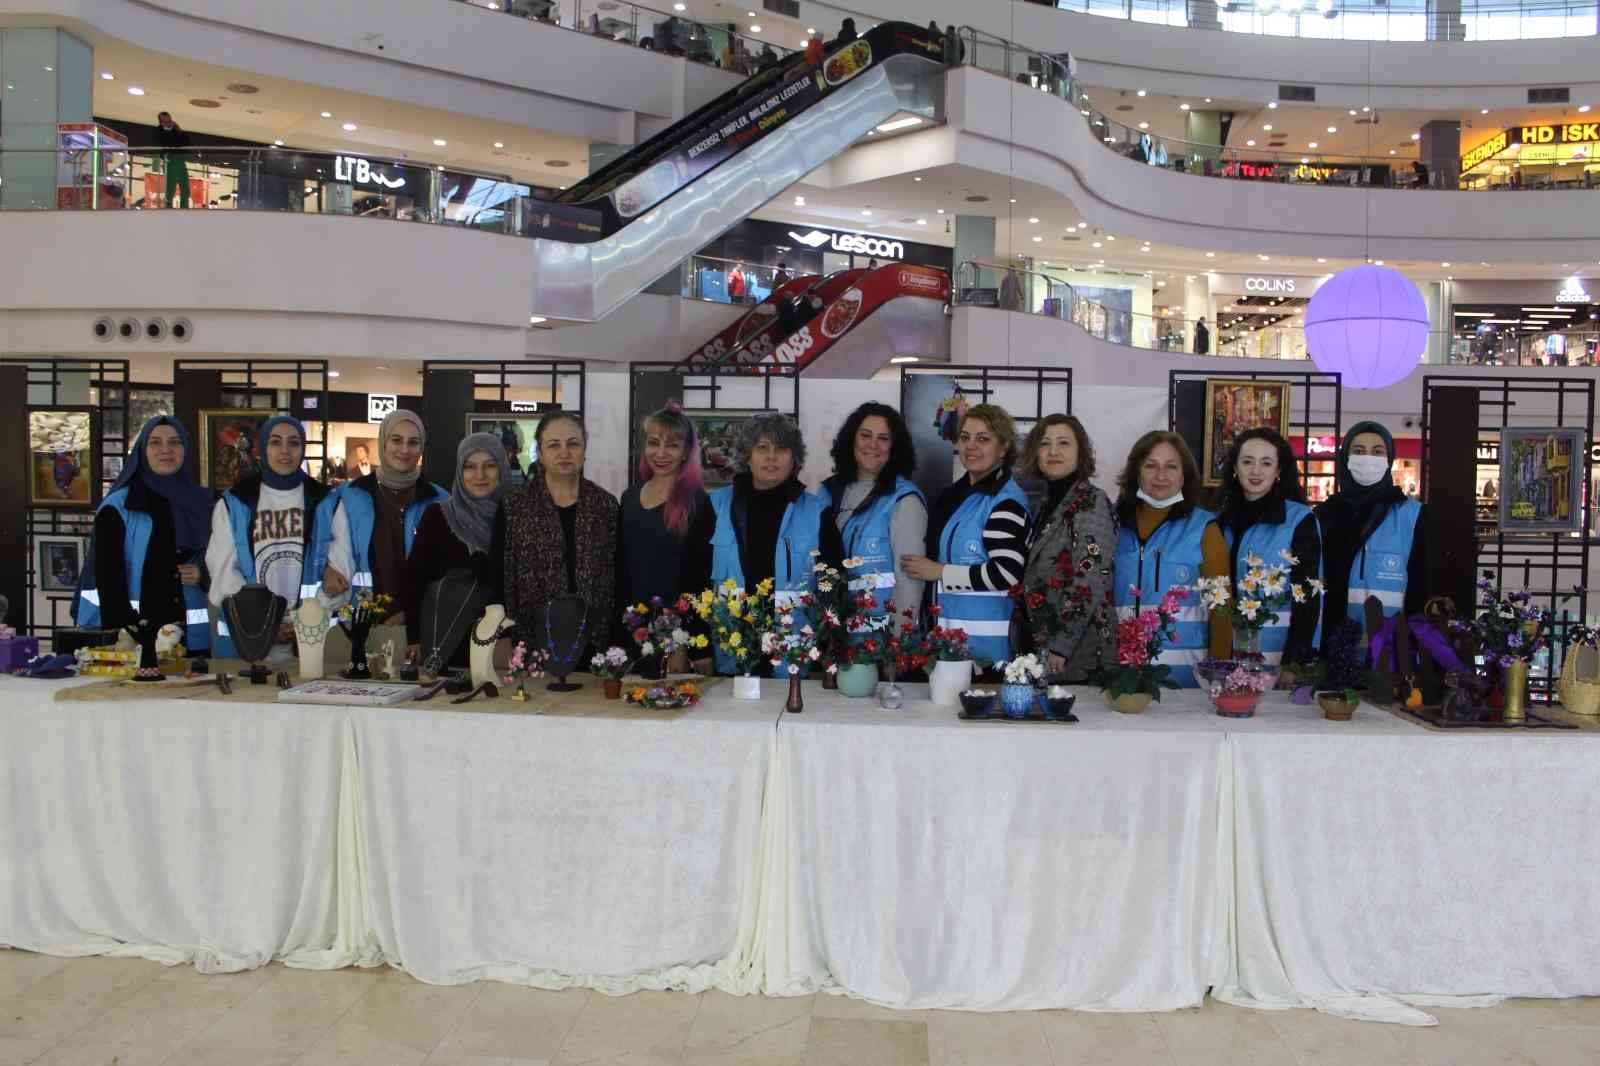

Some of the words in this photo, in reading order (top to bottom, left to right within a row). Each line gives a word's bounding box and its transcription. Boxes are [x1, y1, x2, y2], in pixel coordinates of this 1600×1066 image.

[1522, 126, 1555, 143] HD
[335, 155, 370, 183] LTB
[1246, 278, 1295, 292] COLIN'S
[1556, 289, 1591, 303] adidas
